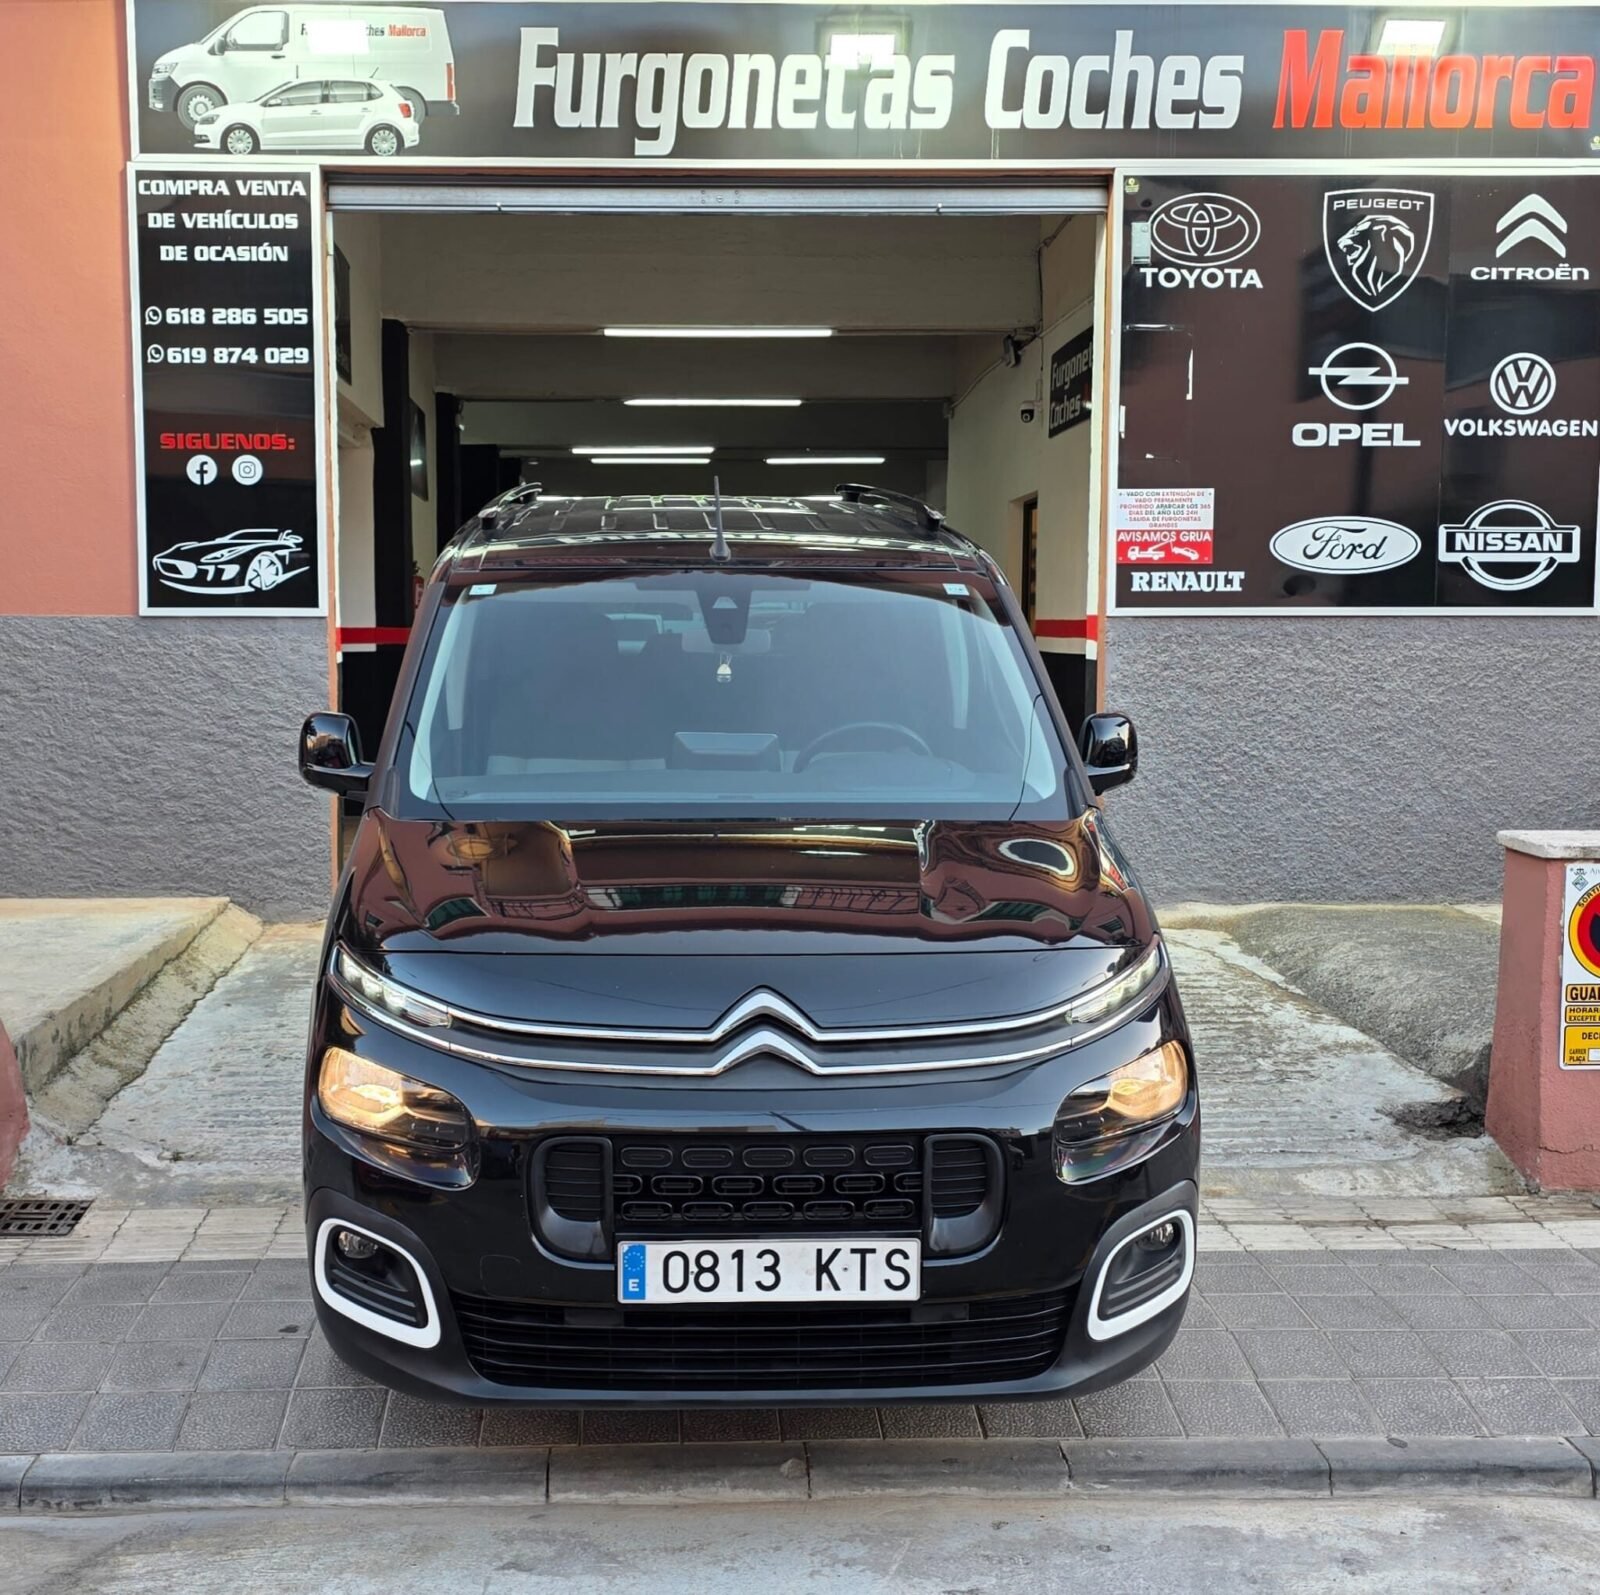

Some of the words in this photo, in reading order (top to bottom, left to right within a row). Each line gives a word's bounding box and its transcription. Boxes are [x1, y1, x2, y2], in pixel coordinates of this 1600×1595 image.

[388, 24, 426, 37] Mallorca
[513, 27, 956, 156] Furgonetas
[984, 29, 1245, 129] Coches
[1272, 29, 1595, 129] Mallorca
[138, 179, 230, 196] COMPRA
[235, 180, 307, 197] VENTA
[1333, 198, 1424, 211] PEUGEOT
[148, 212, 176, 229] DE
[181, 209, 298, 230] VEHÍCULOS
[160, 245, 188, 262] DE
[194, 242, 289, 262] OCASIÓN
[1139, 267, 1264, 289] TOYOTA
[165, 307, 206, 325] 618
[212, 307, 257, 325] 286
[264, 307, 308, 325] 505
[167, 347, 207, 364] 619
[213, 347, 258, 364] 874
[264, 347, 309, 365] 029
[1050, 394, 1081, 430] Coches
[1292, 423, 1421, 447] OPEL
[1444, 418, 1598, 437] VOLKSWAGEN
[159, 432, 296, 450] SIGUENOS:
[1117, 531, 1177, 542] AVISAMOS
[1179, 531, 1212, 542] GRUA
[1303, 526, 1388, 560] Ford
[1454, 532, 1563, 552] NISSAN
[1130, 571, 1245, 592] RENAULT
[1578, 885, 1600, 908] SORTI
[1570, 986, 1600, 1001] GUA
[1582, 1032, 1600, 1040] DEC
[662, 1248, 781, 1293] 0813
[815, 1247, 911, 1292] KTS
[628, 1279, 639, 1291] E
